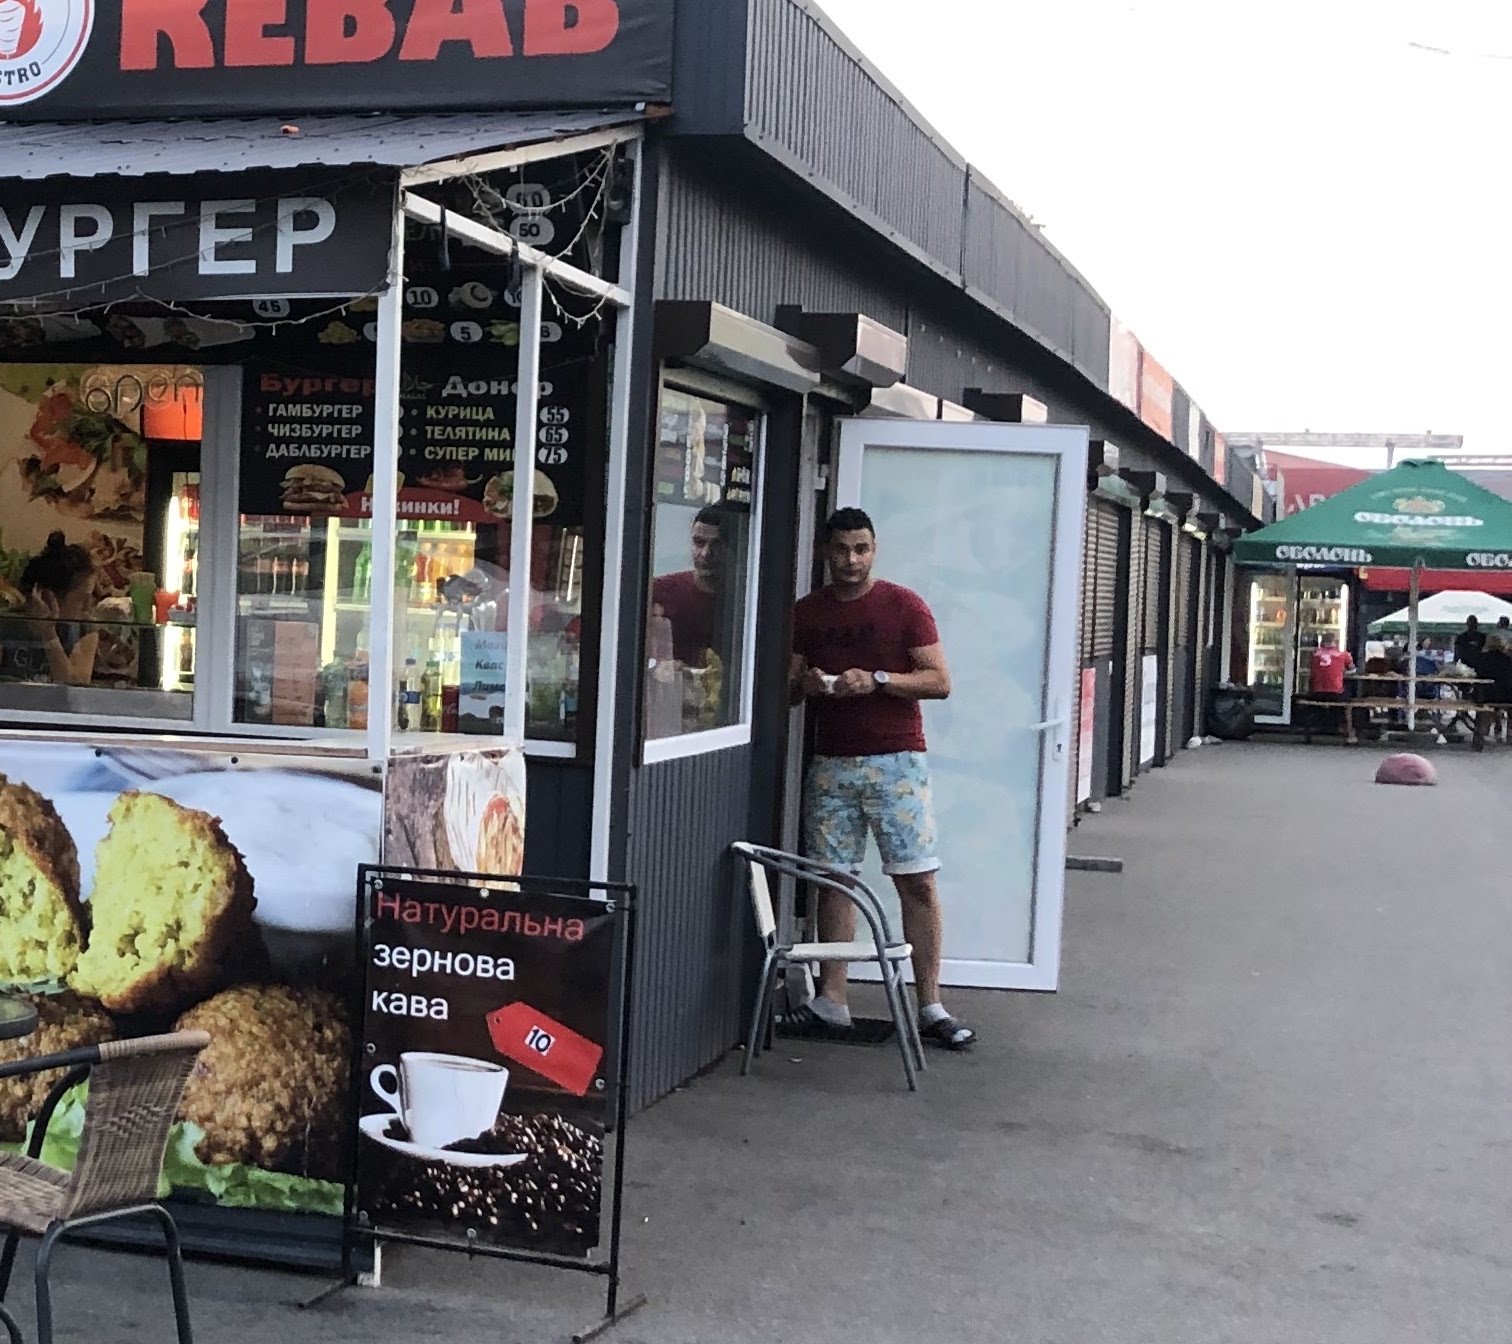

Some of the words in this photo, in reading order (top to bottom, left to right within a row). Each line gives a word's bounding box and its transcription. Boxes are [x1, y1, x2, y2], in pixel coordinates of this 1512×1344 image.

[519, 223, 540, 237] 50
[410, 290, 431, 305] 10
[461, 327, 471, 341] 5
[269, 403, 363, 417] ГАМБУРГЕР
[426, 405, 495, 422] КУРИЦА
[546, 406, 564, 422] 55
[267, 423, 363, 437] ЧИЗБУРГЕР
[425, 425, 511, 440] ТЕЛЯТИНА
[545, 426, 564, 442] 65
[265, 443, 372, 458] ДАБЛБУРГЕР
[425, 446, 479, 461] СУПЕР
[1465, 552, 1512, 567] ОБО
[376, 891, 585, 941] Натуральна
[372, 943, 516, 981] зернова
[371, 989, 449, 1020] кава
[528, 1028, 553, 1054] 10
